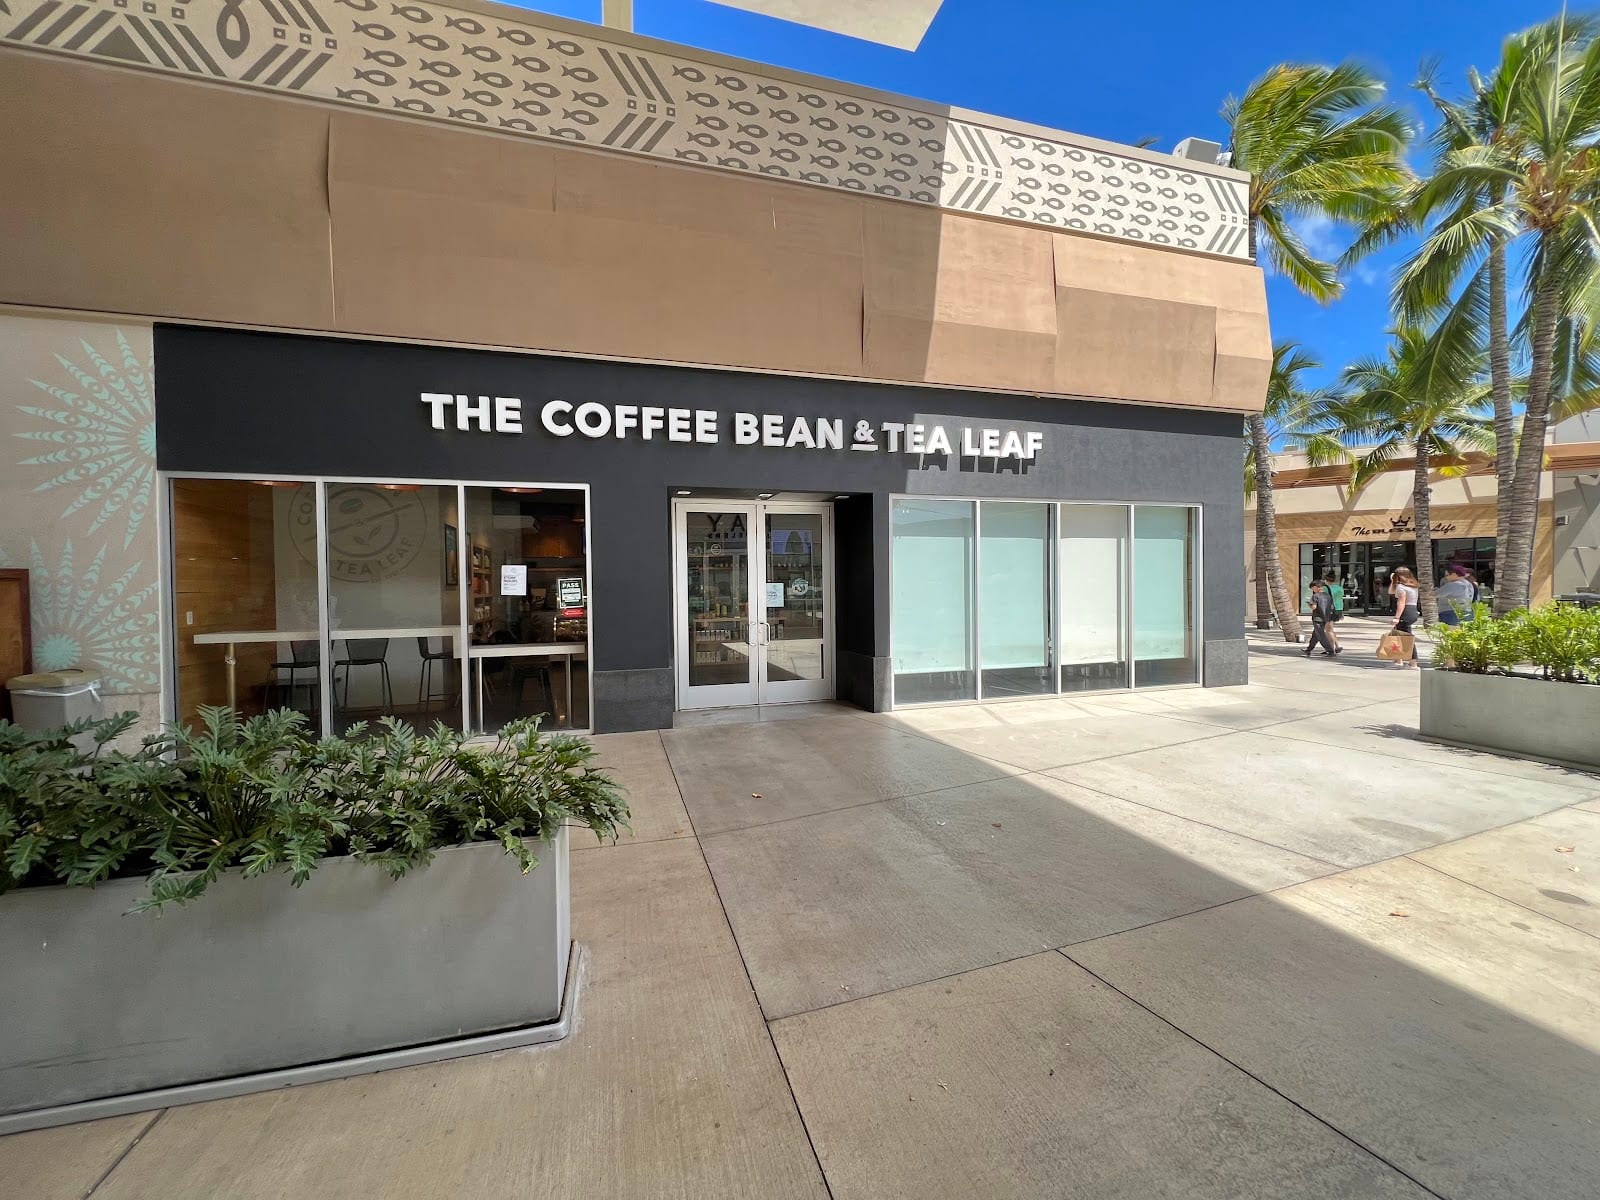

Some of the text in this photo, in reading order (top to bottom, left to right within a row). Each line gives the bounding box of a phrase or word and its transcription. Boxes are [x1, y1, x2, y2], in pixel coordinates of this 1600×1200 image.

[421, 392, 1043, 459] THE COFFEE BEAN & TEA LEAF
[1352, 526, 1370, 536] The
[336, 536, 414, 576] TEA LEAF
